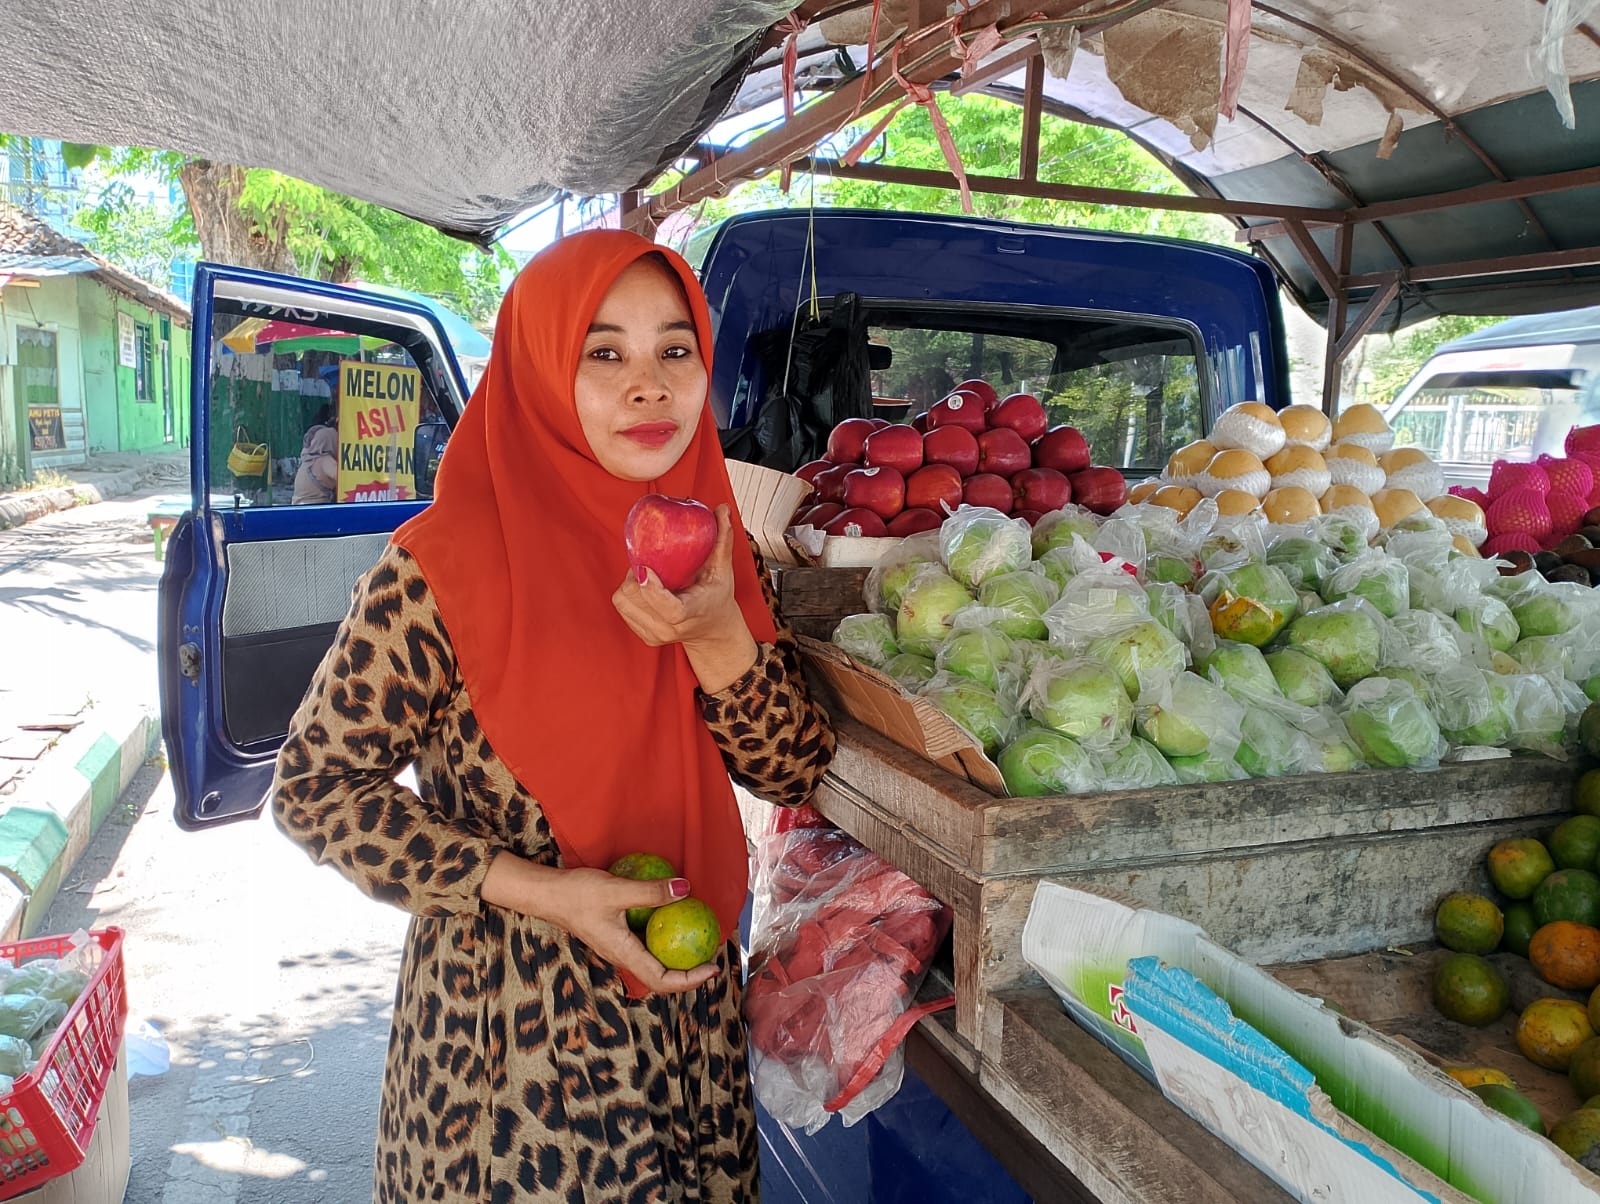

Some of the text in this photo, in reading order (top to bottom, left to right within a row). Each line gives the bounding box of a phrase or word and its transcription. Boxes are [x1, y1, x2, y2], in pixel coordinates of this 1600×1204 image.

[347, 368, 415, 401] MELON
[357, 404, 406, 440] ASLI
[341, 442, 415, 475] KANGEAN
